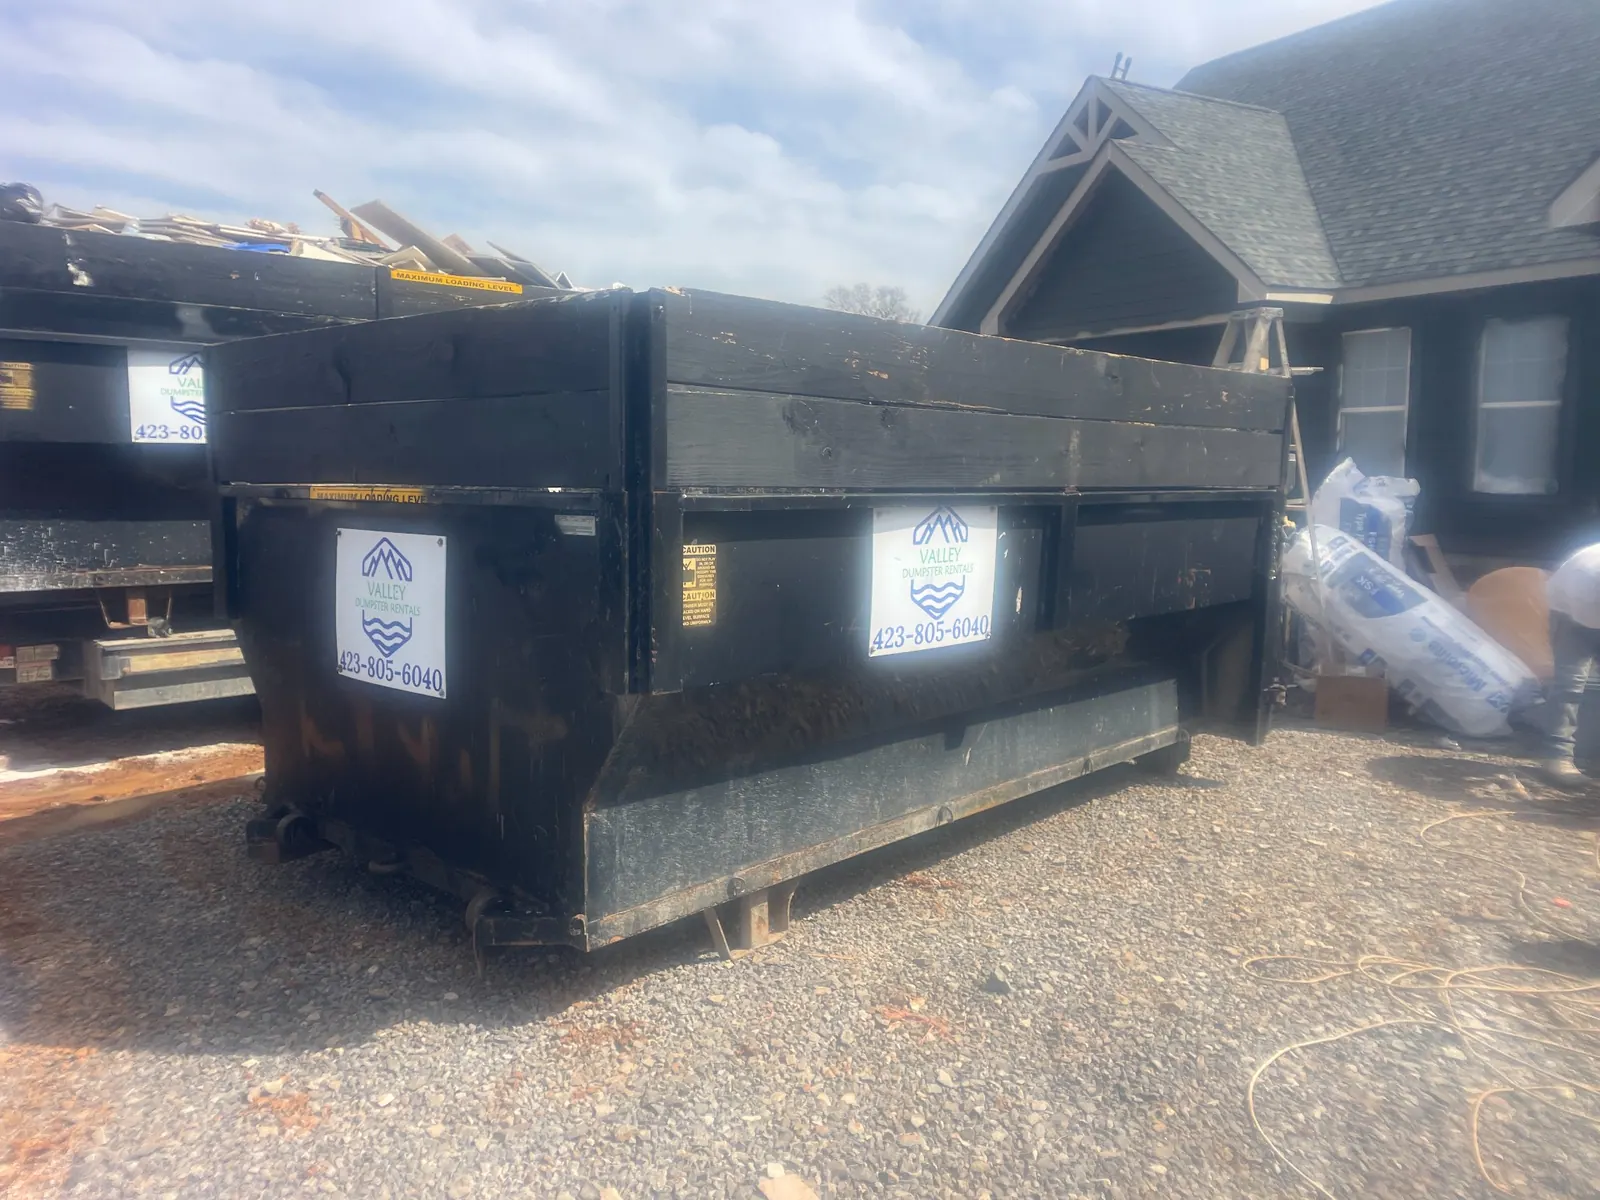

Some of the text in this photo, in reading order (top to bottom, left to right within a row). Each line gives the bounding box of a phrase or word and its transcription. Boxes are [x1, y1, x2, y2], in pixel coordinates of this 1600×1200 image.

[396, 272, 514, 292] MAXIMUM LOADING LEVEL
[177, 377, 204, 388] VAL
[919, 547, 961, 564] VALLEY
[902, 563, 974, 579] DUMPSTER RENTALS
[367, 581, 406, 600] VALLEY
[355, 598, 421, 616] DUMPSTER RENTALS
[873, 614, 989, 650] 423-805-6040
[340, 649, 443, 692] 423-805-6040
